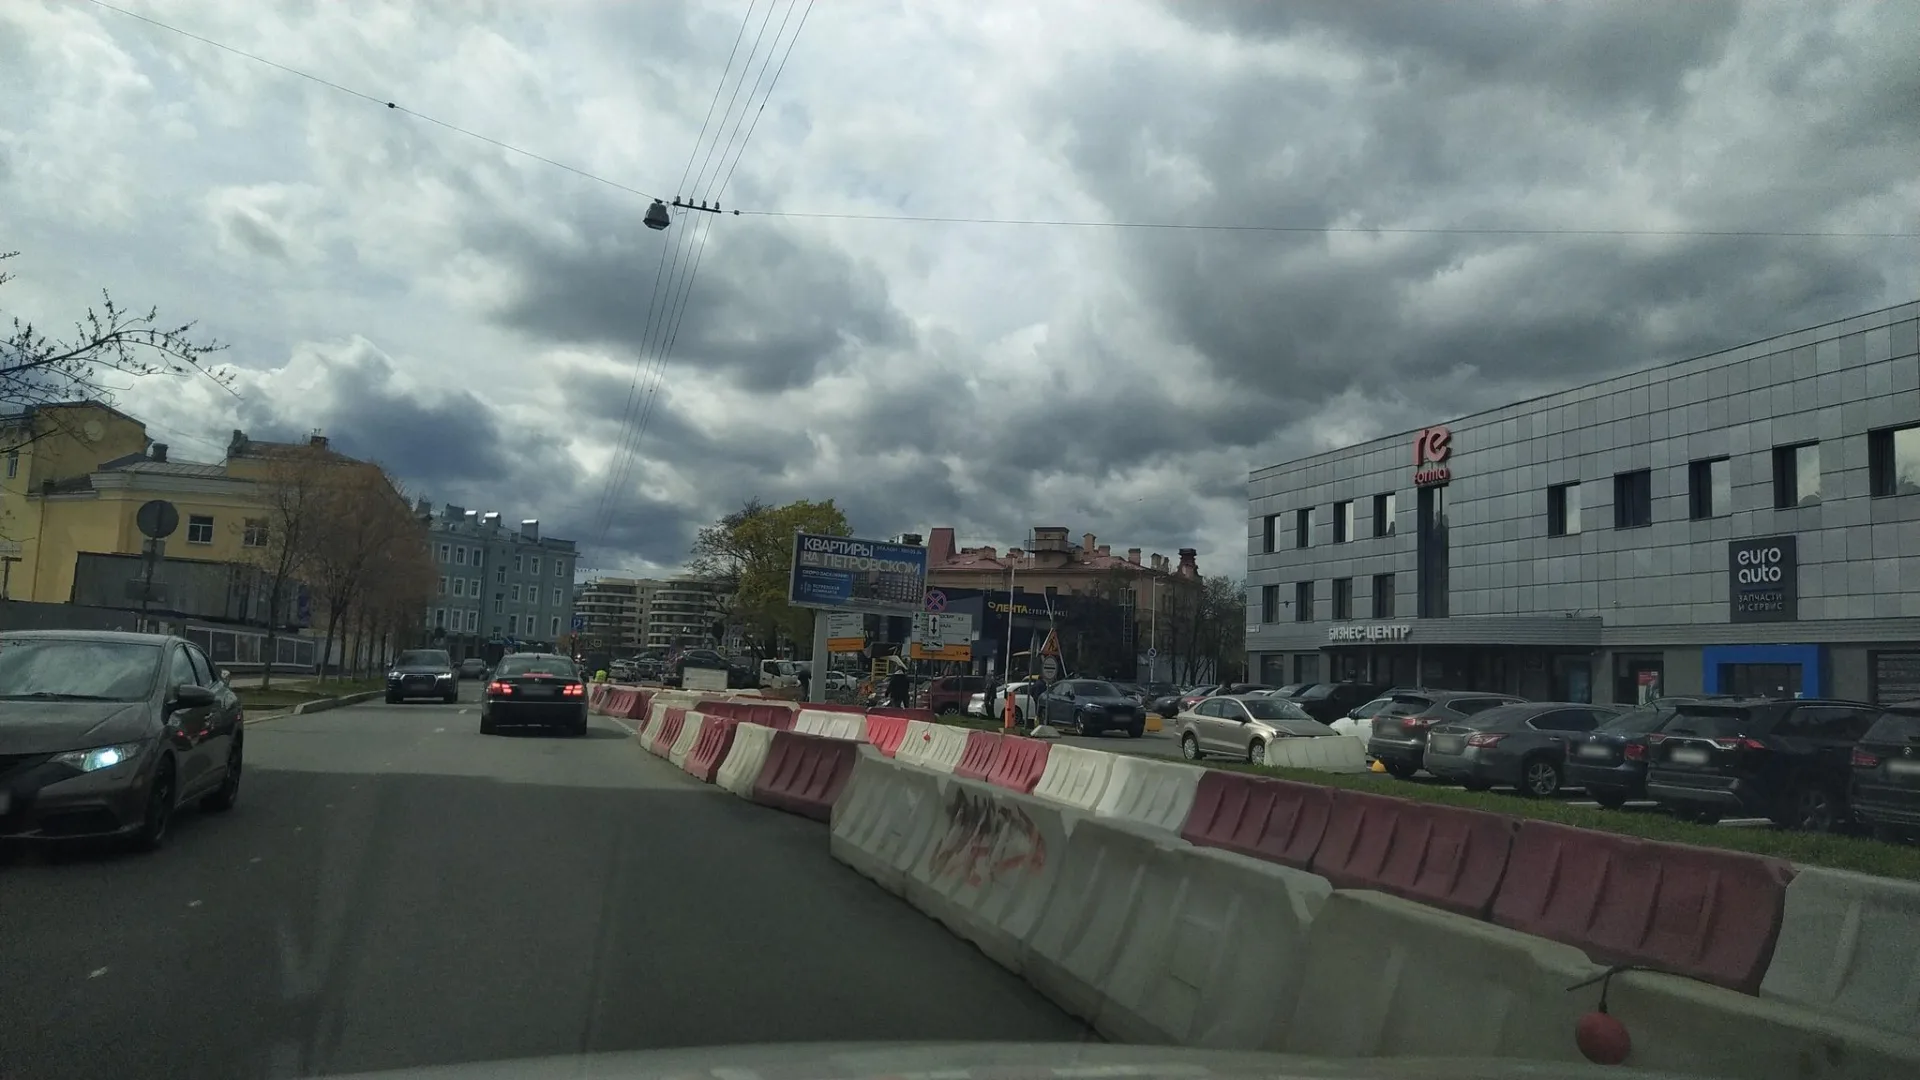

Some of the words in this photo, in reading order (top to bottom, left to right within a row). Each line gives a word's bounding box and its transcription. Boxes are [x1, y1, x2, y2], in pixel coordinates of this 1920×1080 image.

[1413, 426, 1450, 466] re
[804, 537, 873, 557] КВАРТИРЫ
[1737, 547, 1781, 565] euro
[803, 551, 818, 562] НА
[823, 552, 920, 575] ПЕТРОВСКОМ
[1738, 564, 1781, 583] auto
[1738, 593, 1782, 602] ЗАПЧАСТИ
[1747, 602, 1783, 611] СЕРВИС
[996, 603, 1028, 614] ЛЕНТА
[1028, 608, 1069, 617] СУПЕРМРКЕТ
[1328, 625, 1410, 641] БИЗНЕС-ЦЕНТР
